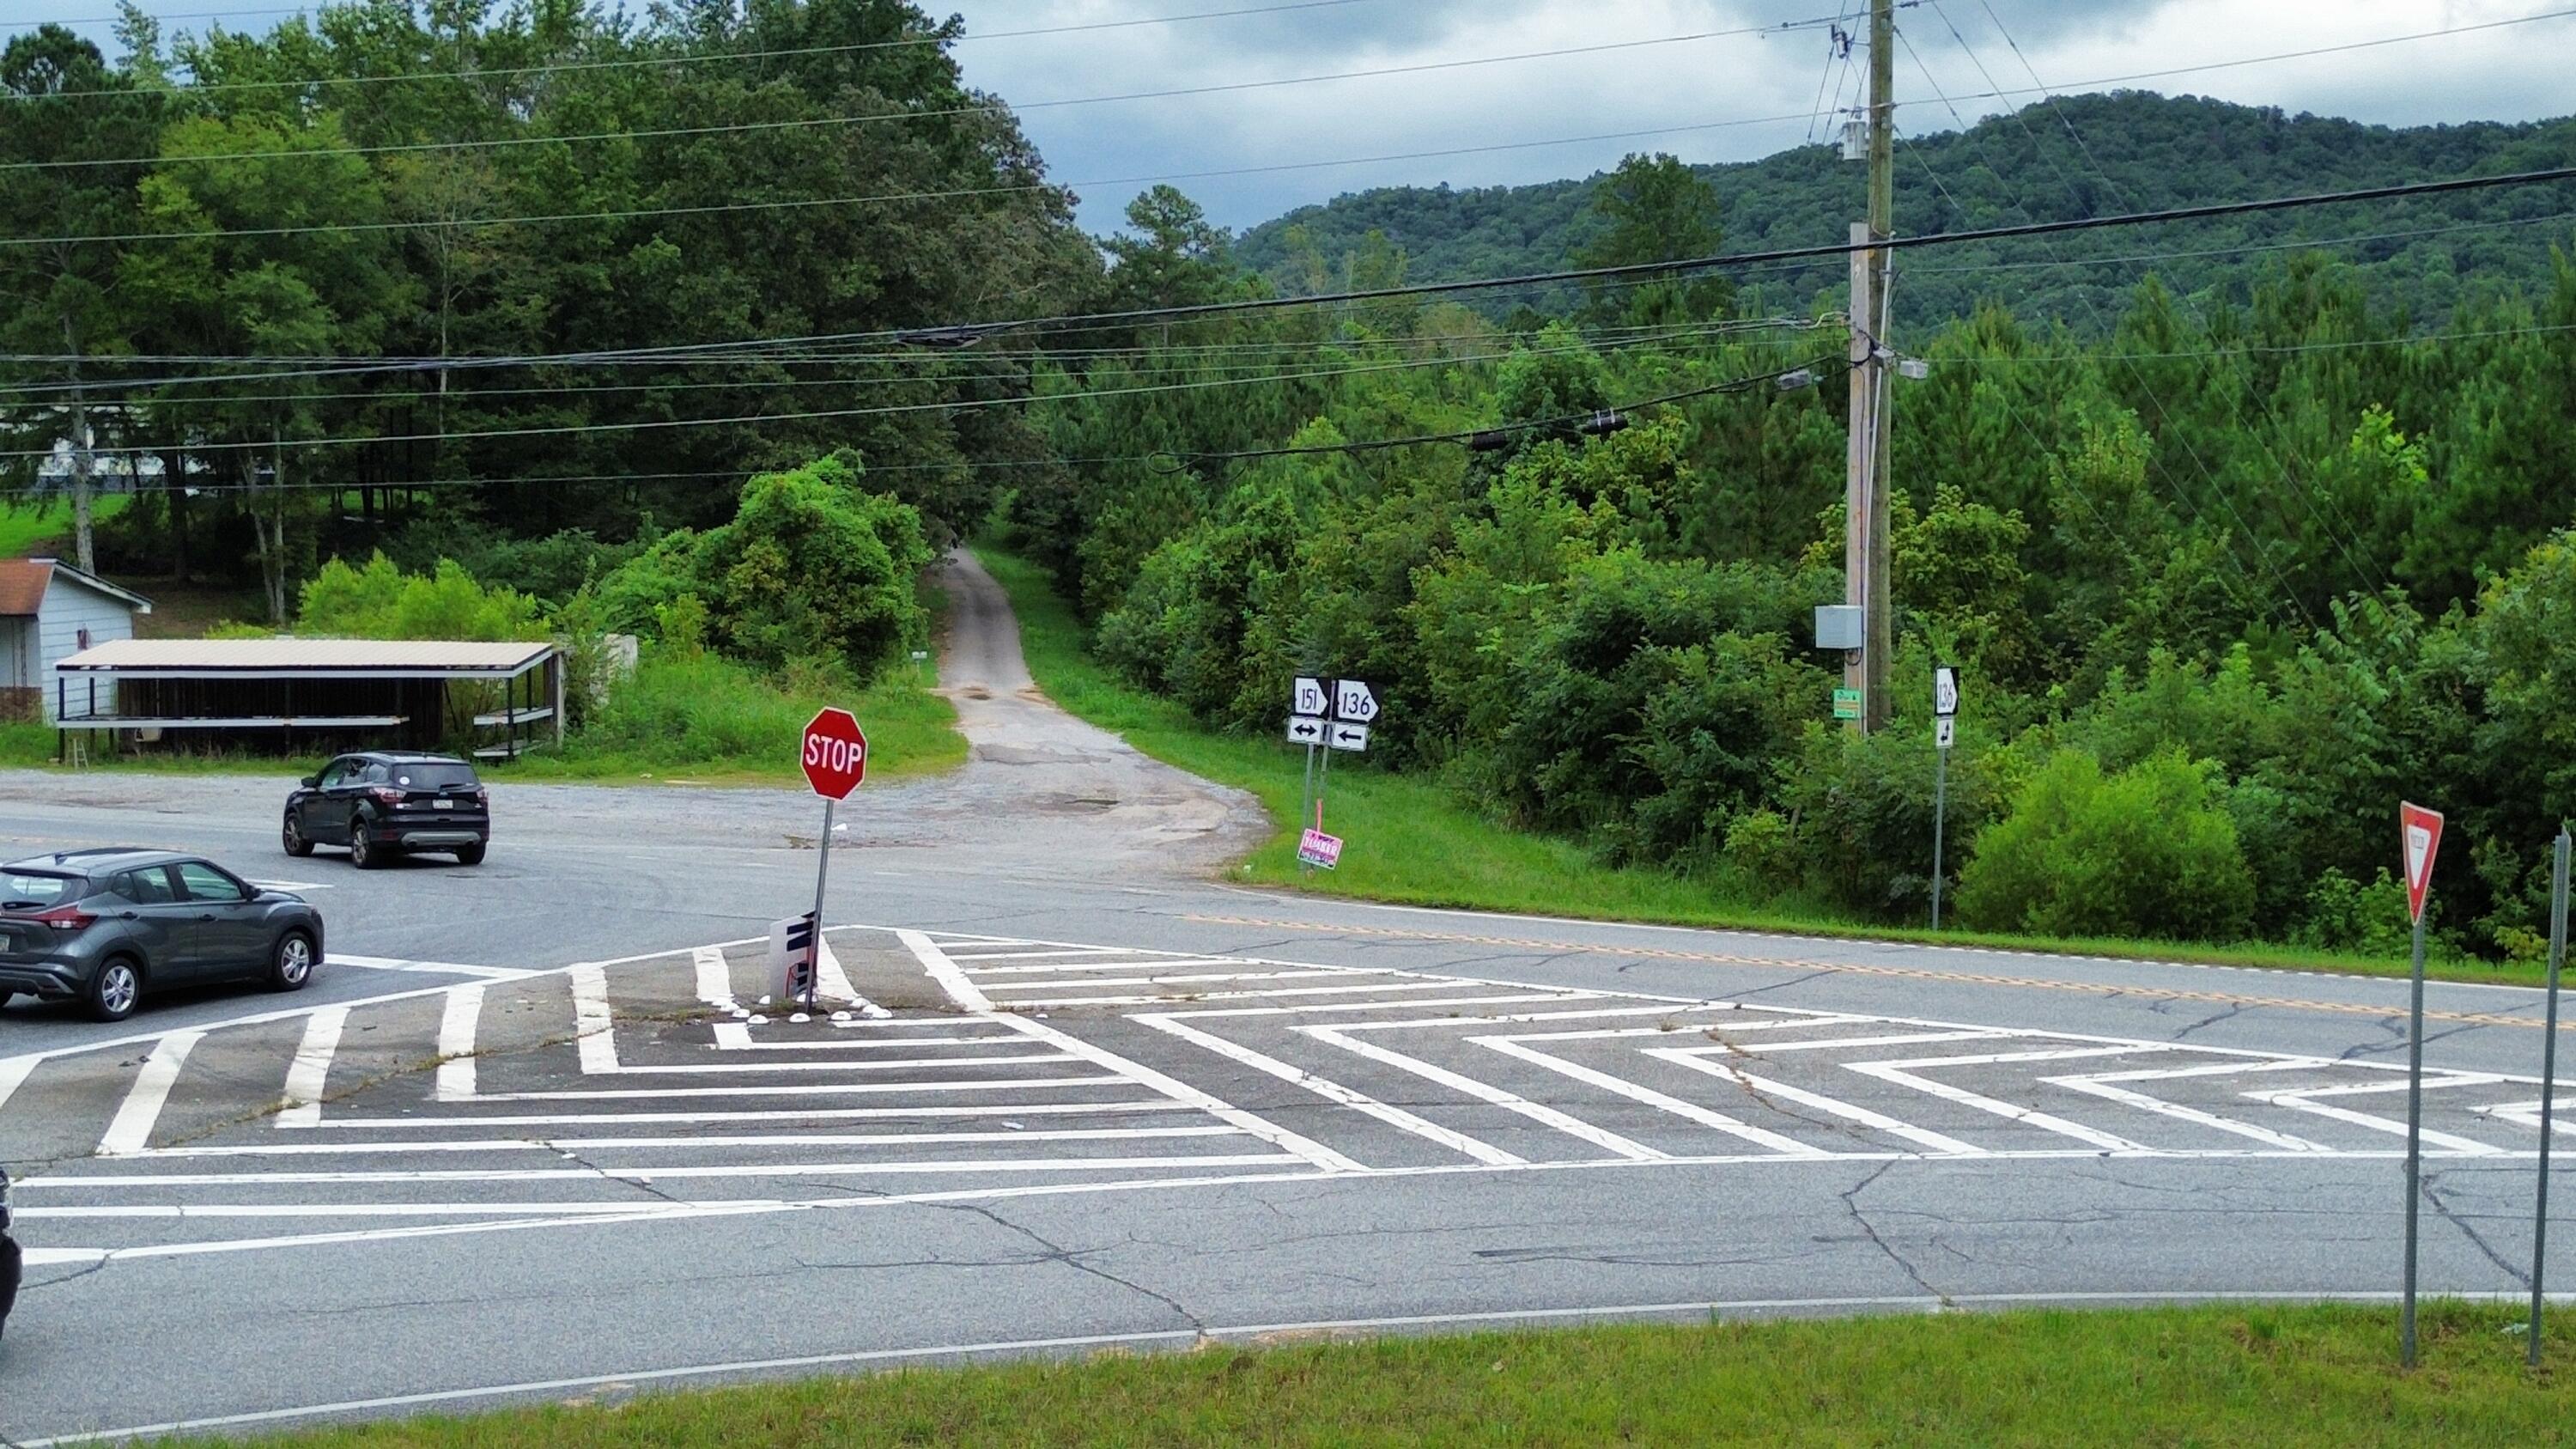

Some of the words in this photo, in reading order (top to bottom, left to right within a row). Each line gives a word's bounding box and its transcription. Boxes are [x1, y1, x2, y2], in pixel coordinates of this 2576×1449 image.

[1301, 688, 1318, 709] 151
[1342, 691, 1370, 715] 136
[1938, 682, 1953, 708] 136
[805, 733, 862, 775] STOP
